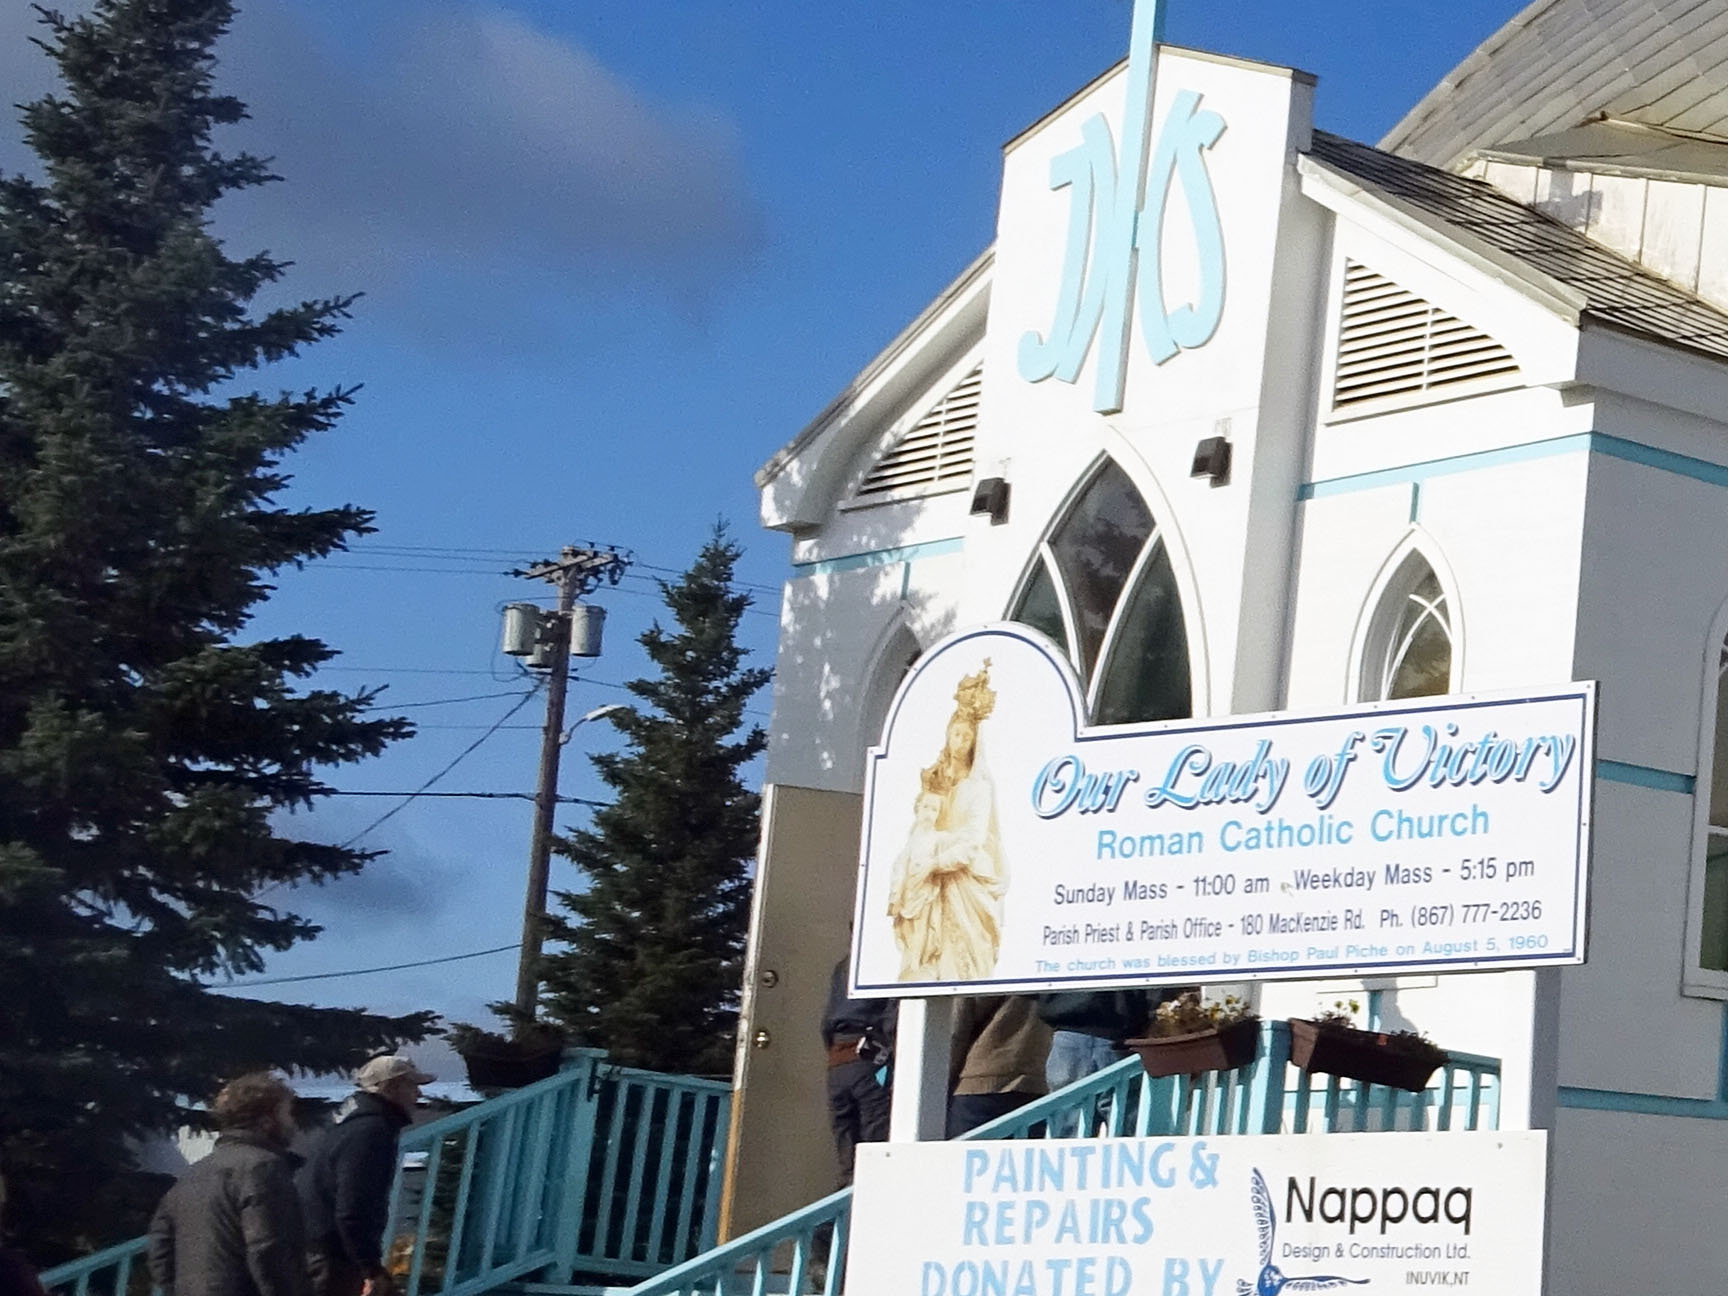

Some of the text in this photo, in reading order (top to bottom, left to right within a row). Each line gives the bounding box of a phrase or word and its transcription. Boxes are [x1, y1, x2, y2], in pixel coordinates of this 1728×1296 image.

[1032, 722, 1576, 820] Our Lady of Victory
[1097, 804, 1490, 860] Roman Catholic Church
[1054, 883, 1116, 906] Sunday
[1123, 880, 1168, 901] Mass
[1193, 873, 1236, 896] 11:00
[1243, 877, 1270, 893] am
[1294, 866, 1376, 891] Weekday
[1384, 863, 1433, 885] Mass
[1460, 857, 1497, 880] 5:15
[1505, 859, 1535, 883] pm
[1043, 923, 1080, 946] Parish
[1084, 921, 1121, 943] Priest
[1125, 921, 1134, 941] &
[1140, 917, 1178, 940] Parish
[1183, 916, 1222, 938] Office
[1240, 913, 1262, 936] 180
[1269, 911, 1338, 934] MacKenzie
[1344, 908, 1365, 930] Rd.
[1380, 908, 1403, 928] Ph.
[1411, 903, 1454, 929] (867)
[1462, 899, 1542, 924] 777-2236
[1036, 934, 1549, 973] The church was blessed by Bishop Paul Piche on August 5, 1960
[963, 1141, 1220, 1193] PAINTING &
[963, 1196, 1154, 1247] REPAIRS
[1285, 1176, 1472, 1235] Nappaq
[1282, 1242, 1471, 1262] Design & Construction Ltd.
